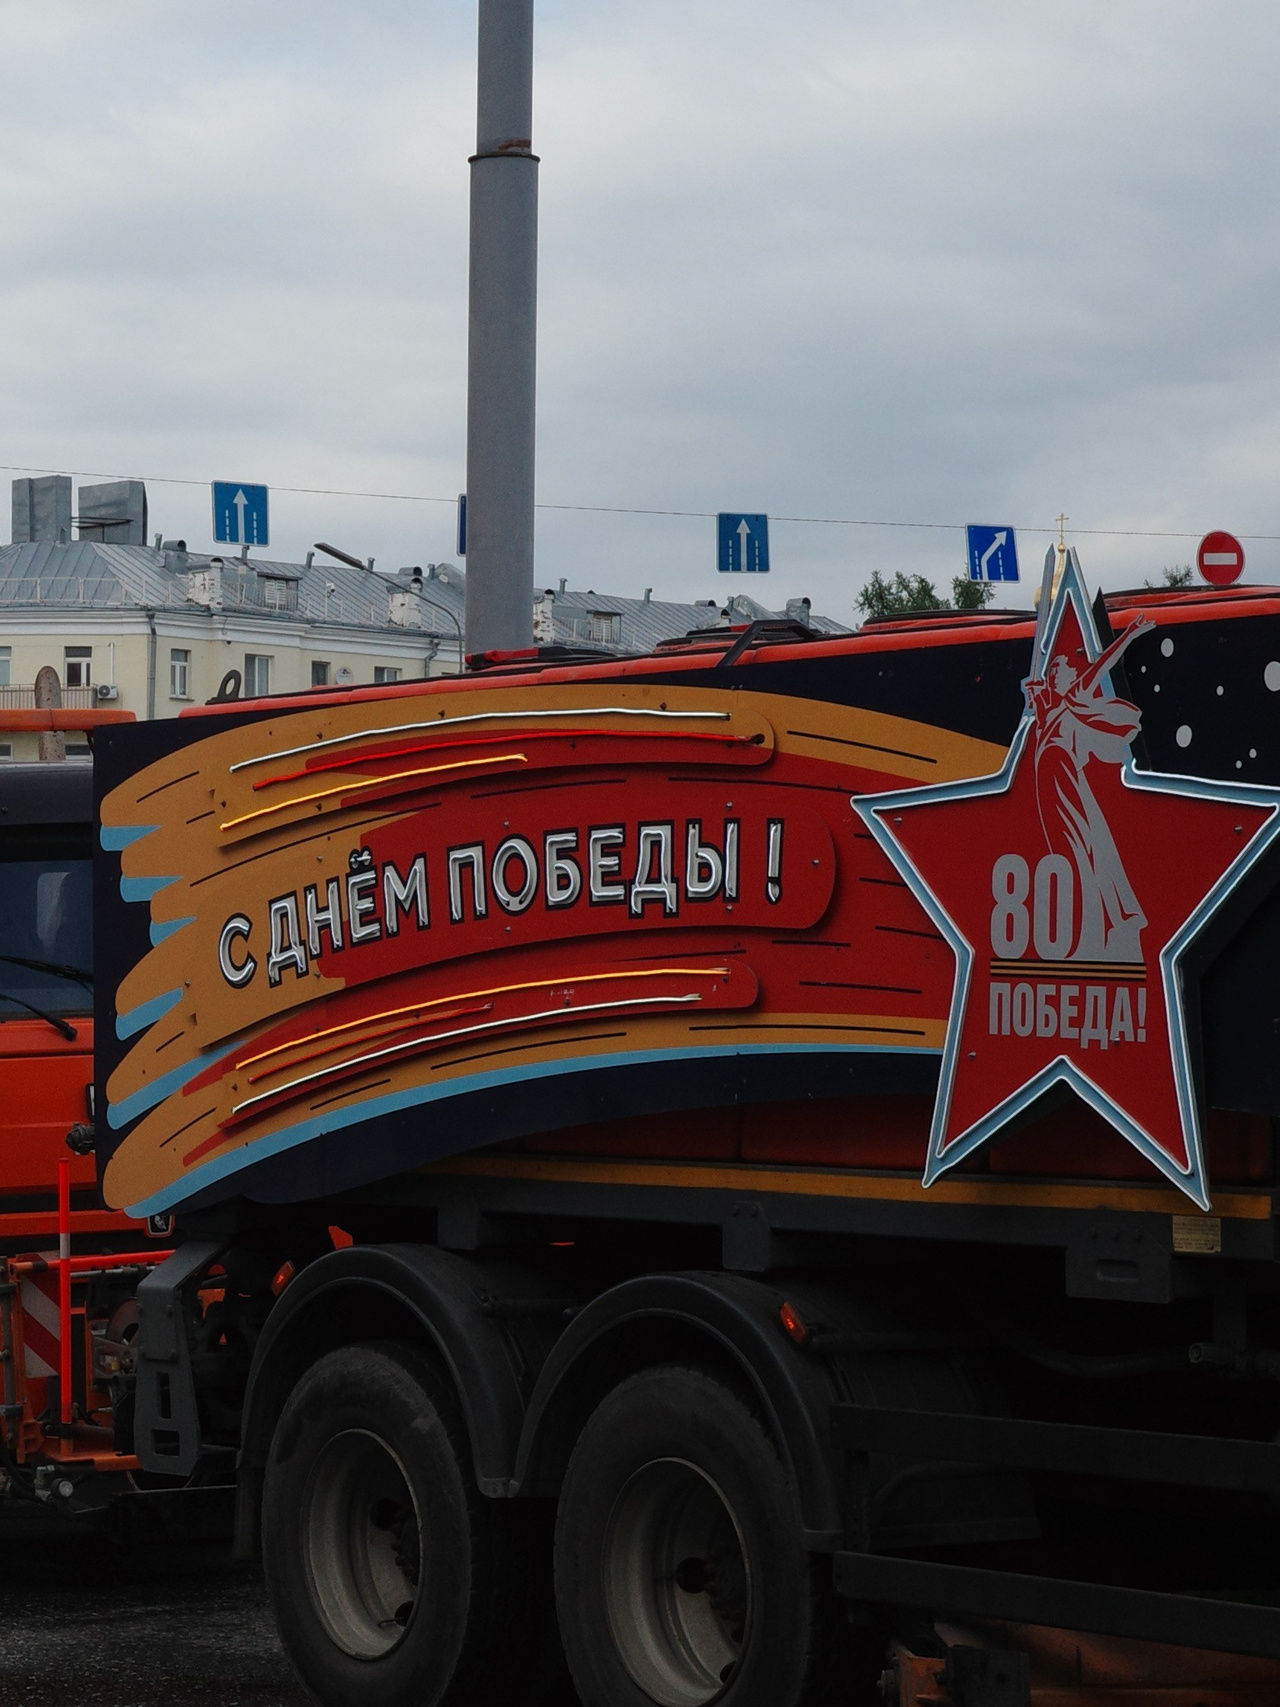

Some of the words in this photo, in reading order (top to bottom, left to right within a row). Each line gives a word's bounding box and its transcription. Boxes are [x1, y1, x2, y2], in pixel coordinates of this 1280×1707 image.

[218, 912, 257, 988] С
[266, 845, 431, 988] ДНЁМ
[990, 853, 1074, 960] 80
[988, 982, 1147, 1050] ПОБЕДА!
